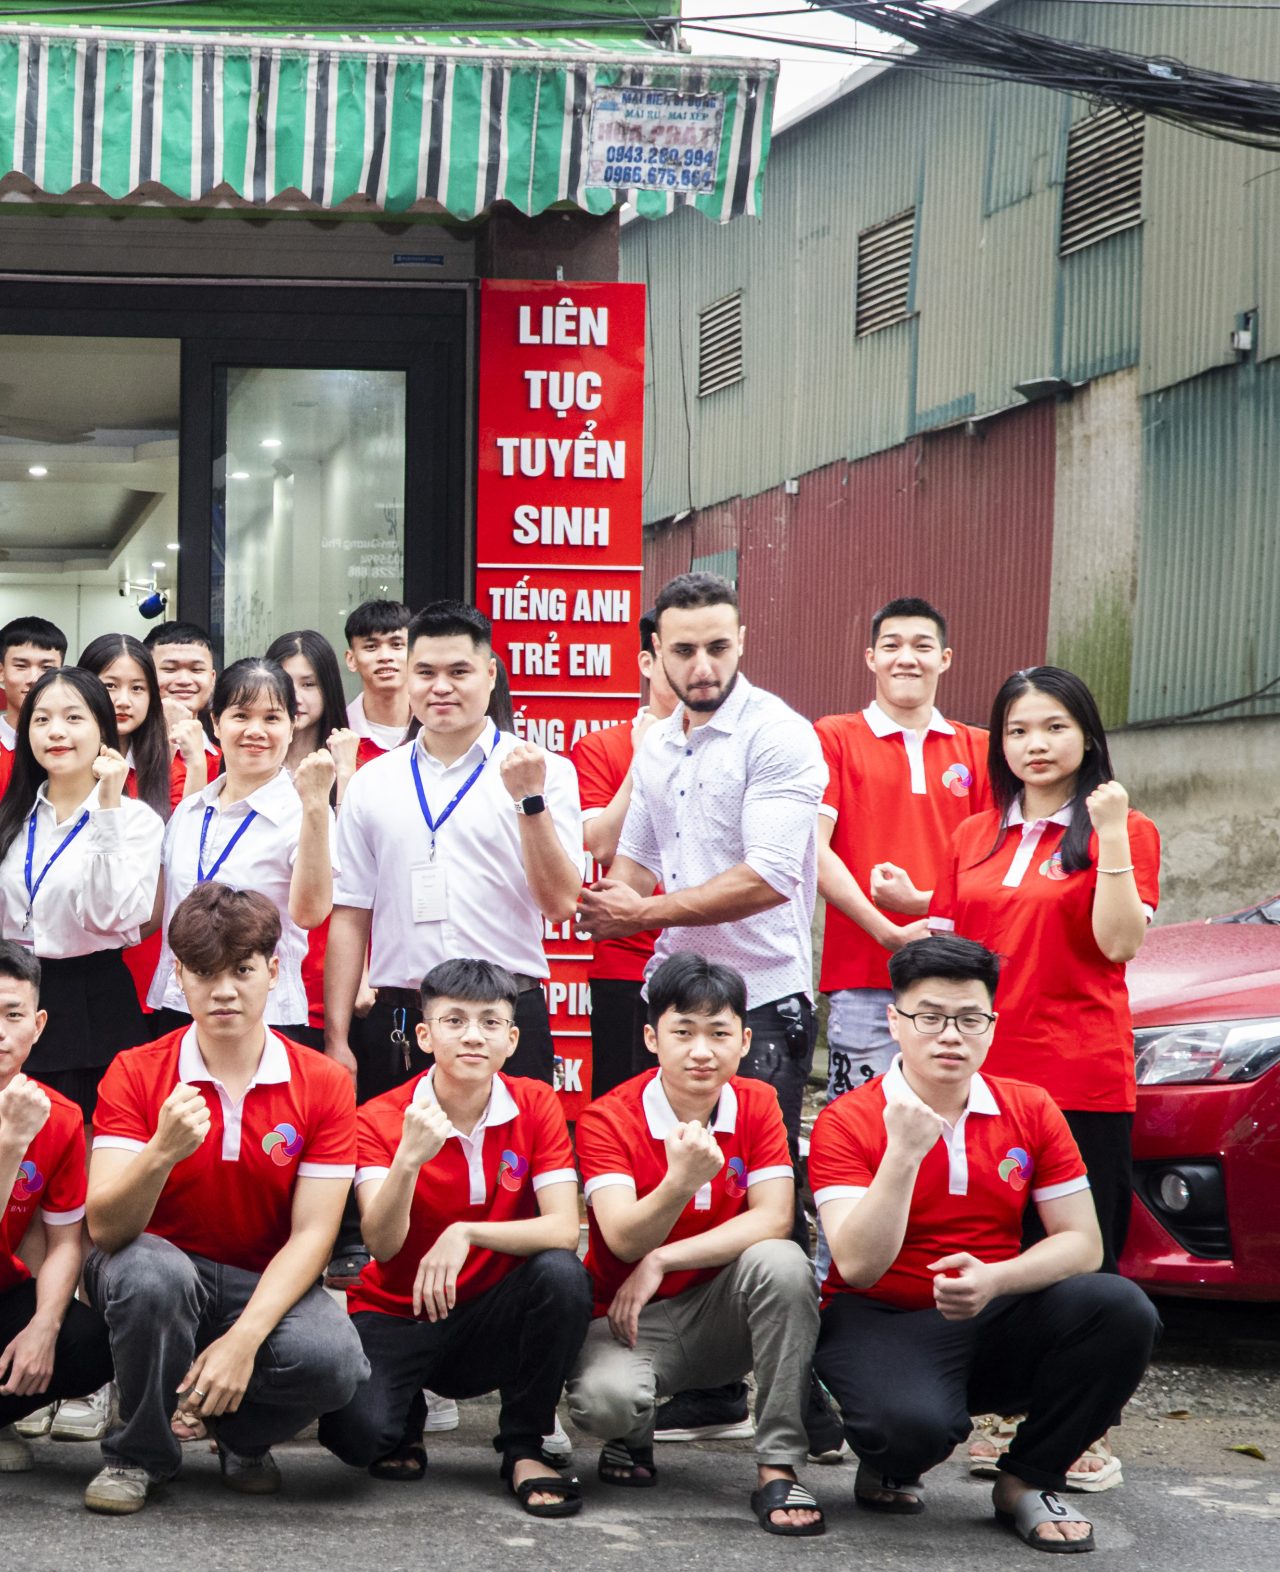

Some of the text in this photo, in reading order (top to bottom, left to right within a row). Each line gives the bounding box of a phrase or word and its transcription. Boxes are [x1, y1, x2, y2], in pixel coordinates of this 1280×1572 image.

[518, 297, 608, 346] LIÊN
[524, 370, 602, 418] TỤC
[496, 419, 626, 479] TUYỂN
[512, 504, 609, 547] SINH
[488, 574, 631, 623] TIẾNG ANH
[508, 631, 612, 678] TRẺ EM
[540, 982, 593, 1016] PIK
